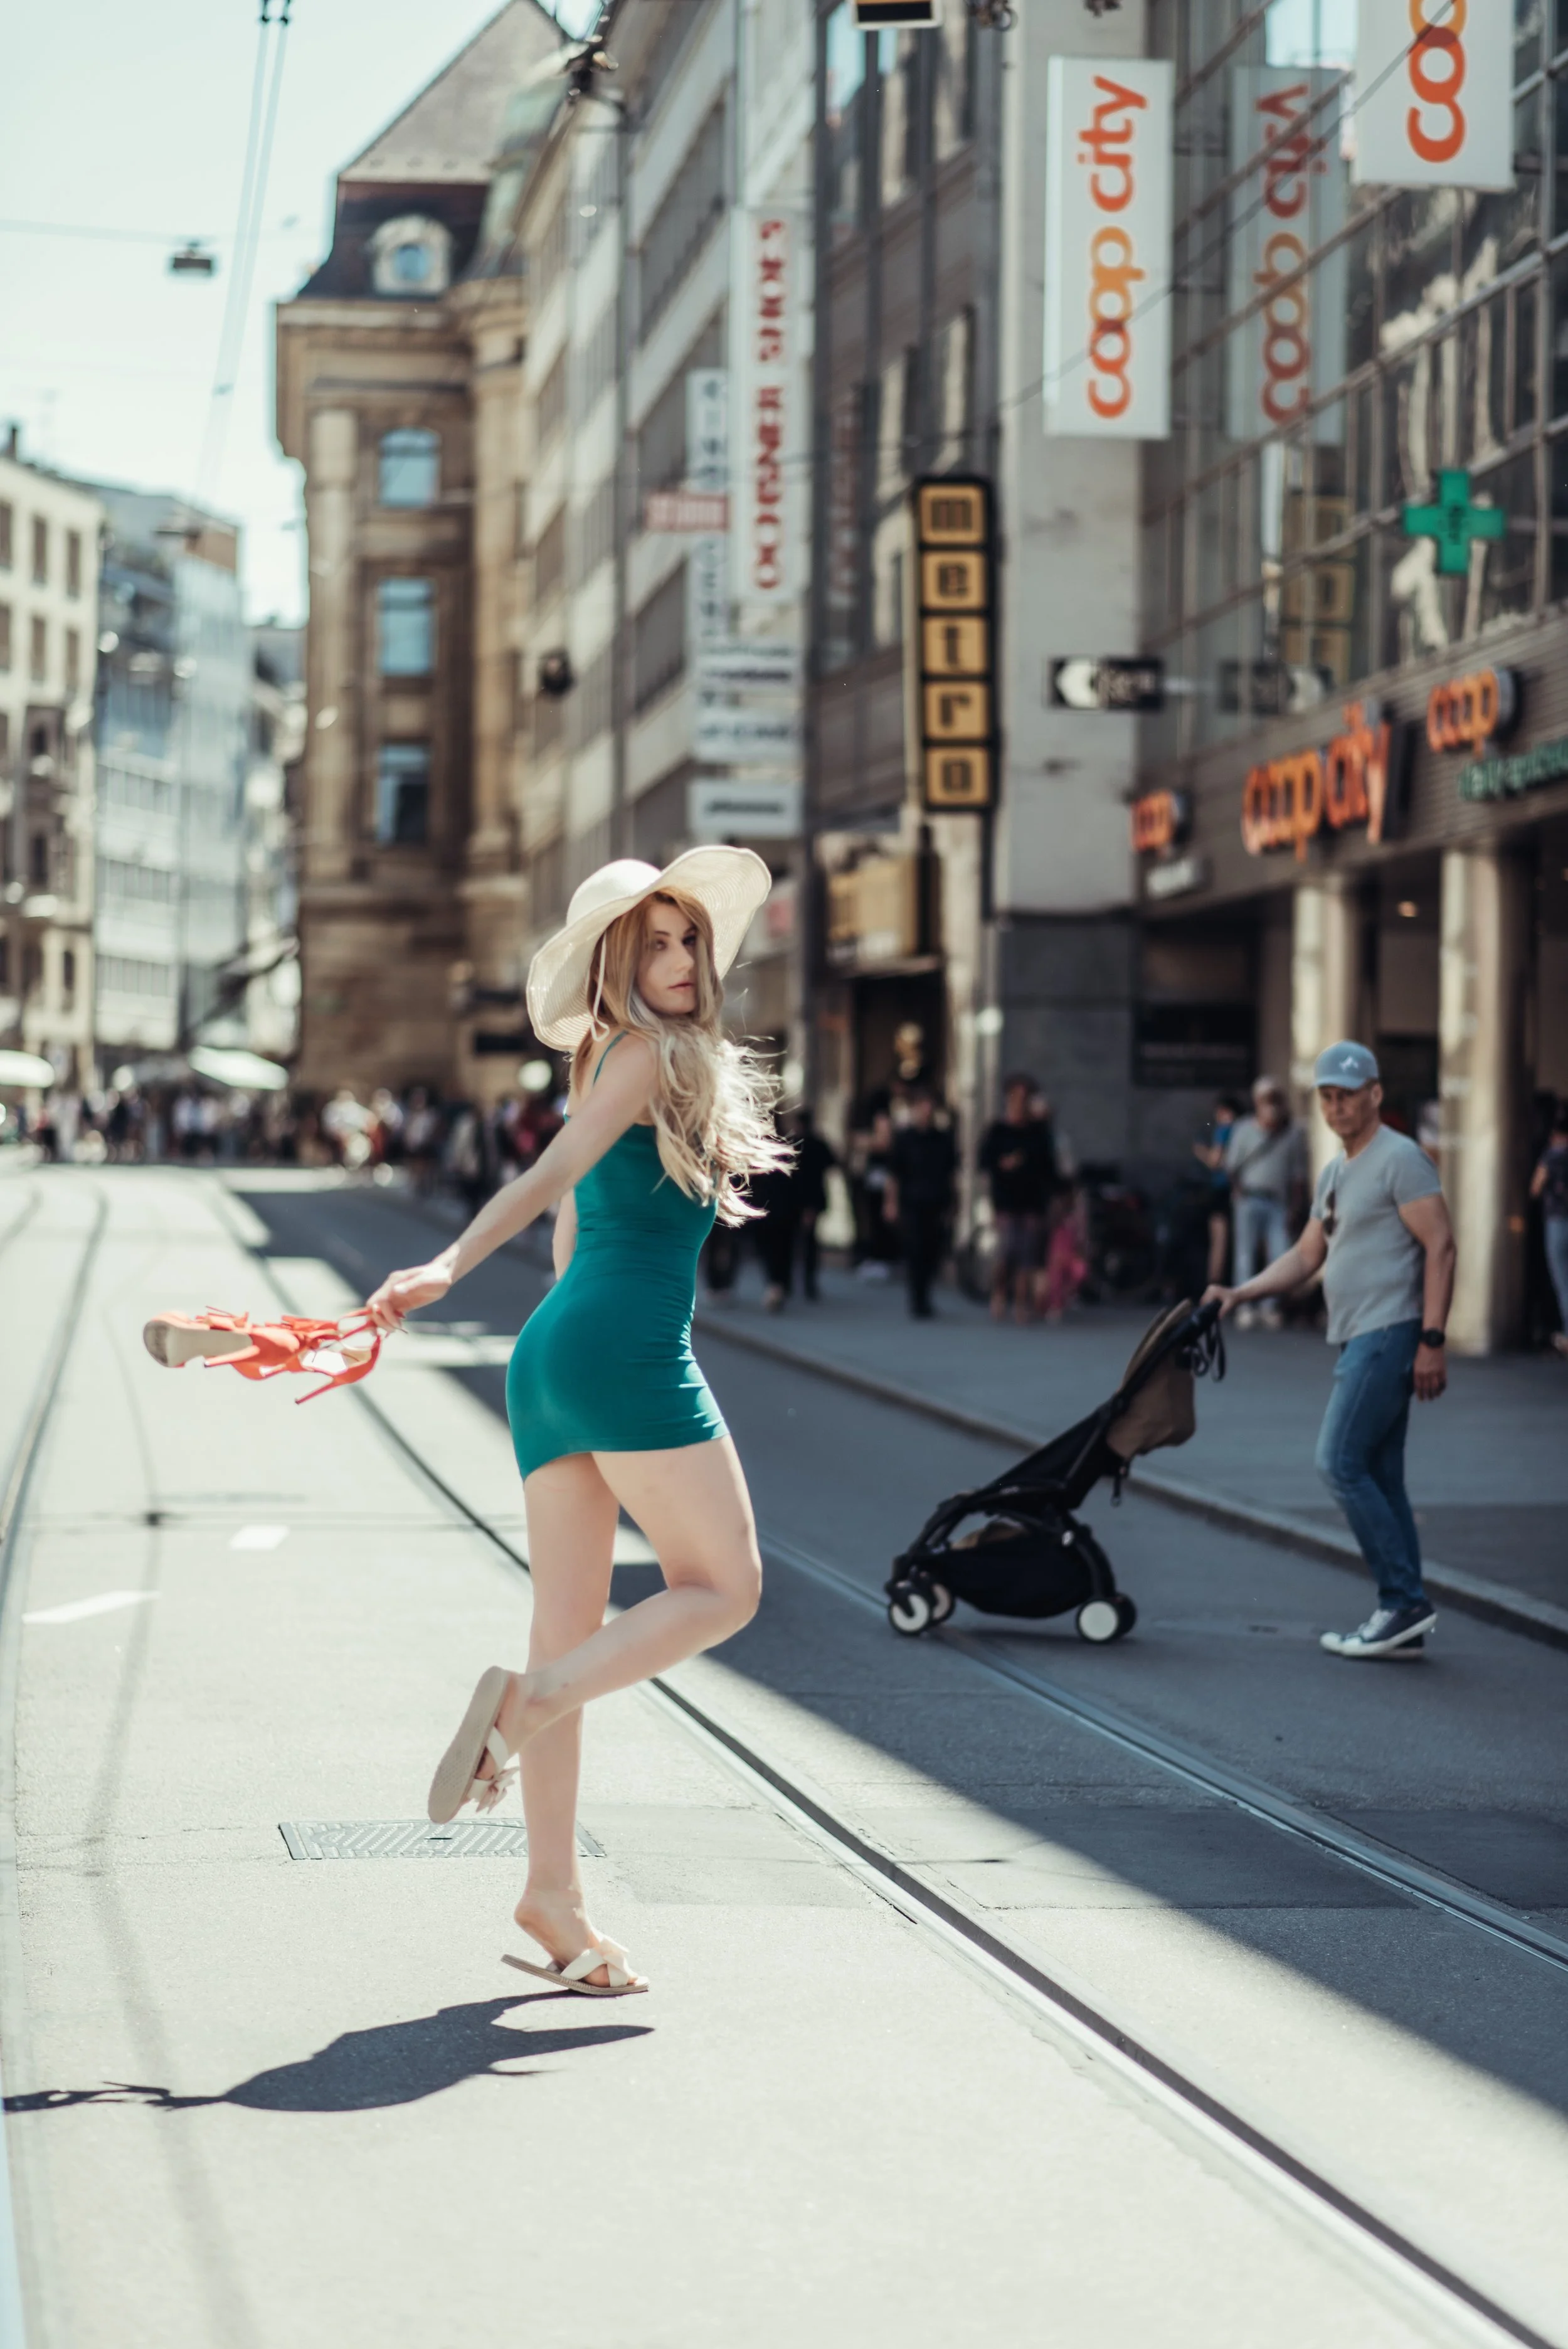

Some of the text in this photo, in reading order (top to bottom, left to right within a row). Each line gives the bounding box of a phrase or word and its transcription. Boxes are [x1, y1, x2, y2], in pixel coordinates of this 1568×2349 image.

[1078, 75, 1147, 419] coop city
[1241, 749, 1322, 864] coop
[1325, 701, 1391, 845] city
[1427, 668, 1498, 763] coop
